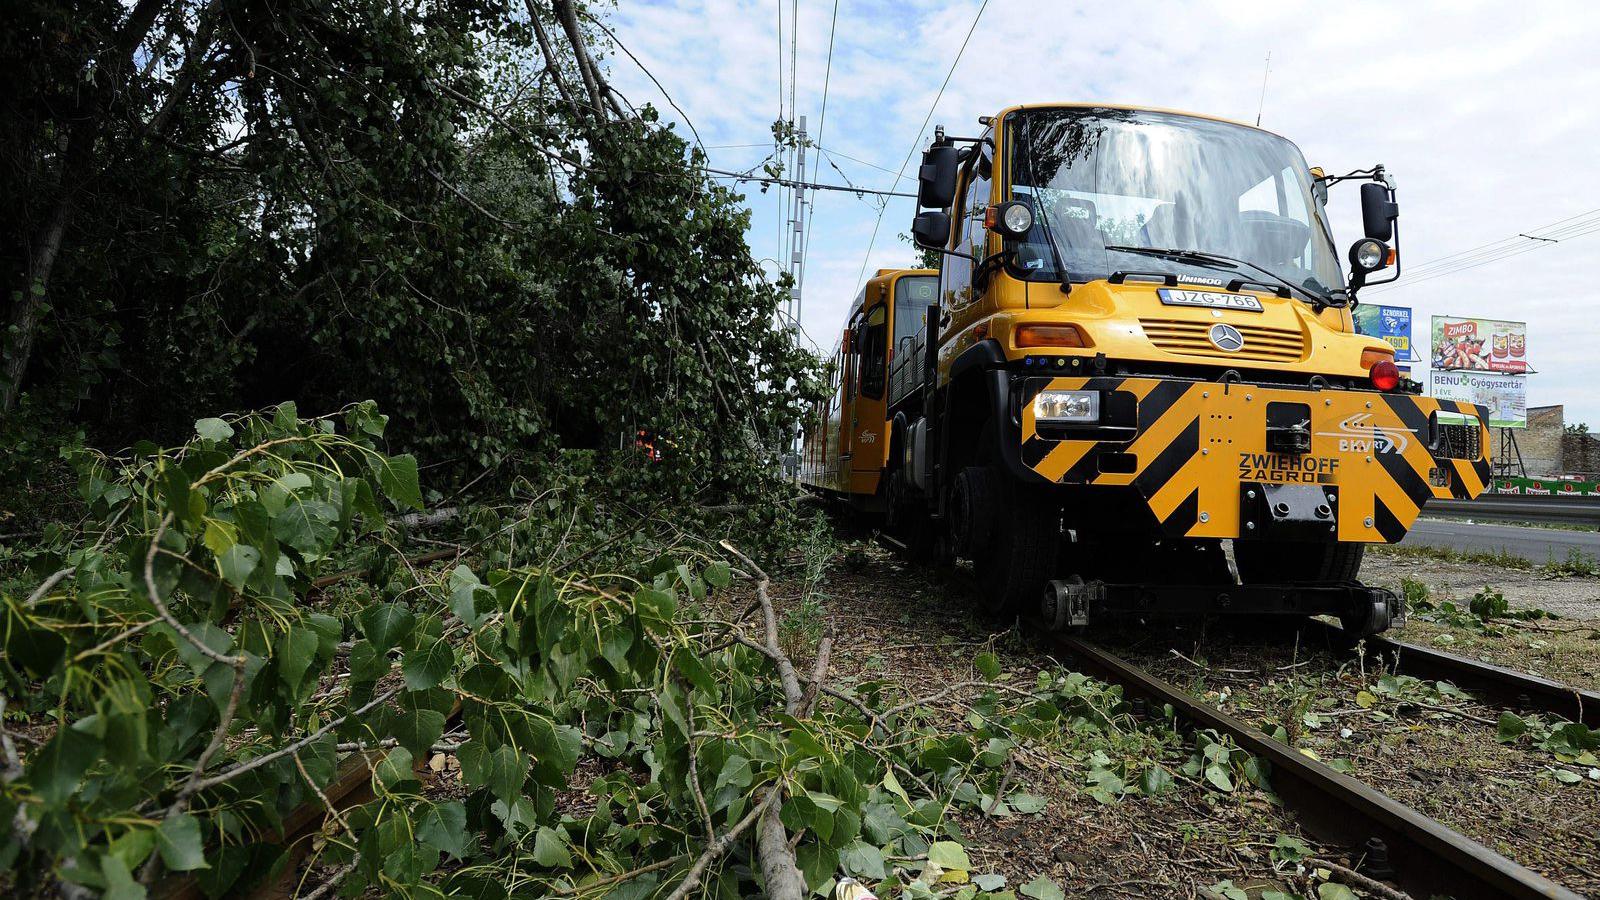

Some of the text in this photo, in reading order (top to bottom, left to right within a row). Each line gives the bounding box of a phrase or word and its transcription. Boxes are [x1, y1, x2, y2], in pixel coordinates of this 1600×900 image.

[1177, 275, 1222, 284] UNIMOG
[1176, 292, 1256, 307] JZG-766
[1383, 309, 1408, 317] SZNORKEL
[1448, 324, 1473, 335] ZIMBO
[1434, 376, 1523, 389] BENU Gyógyszertár
[1339, 439, 1372, 453] BKV
[1239, 453, 1340, 473] ZWIEHOFF
[1238, 468, 1315, 483] ZAGRO
